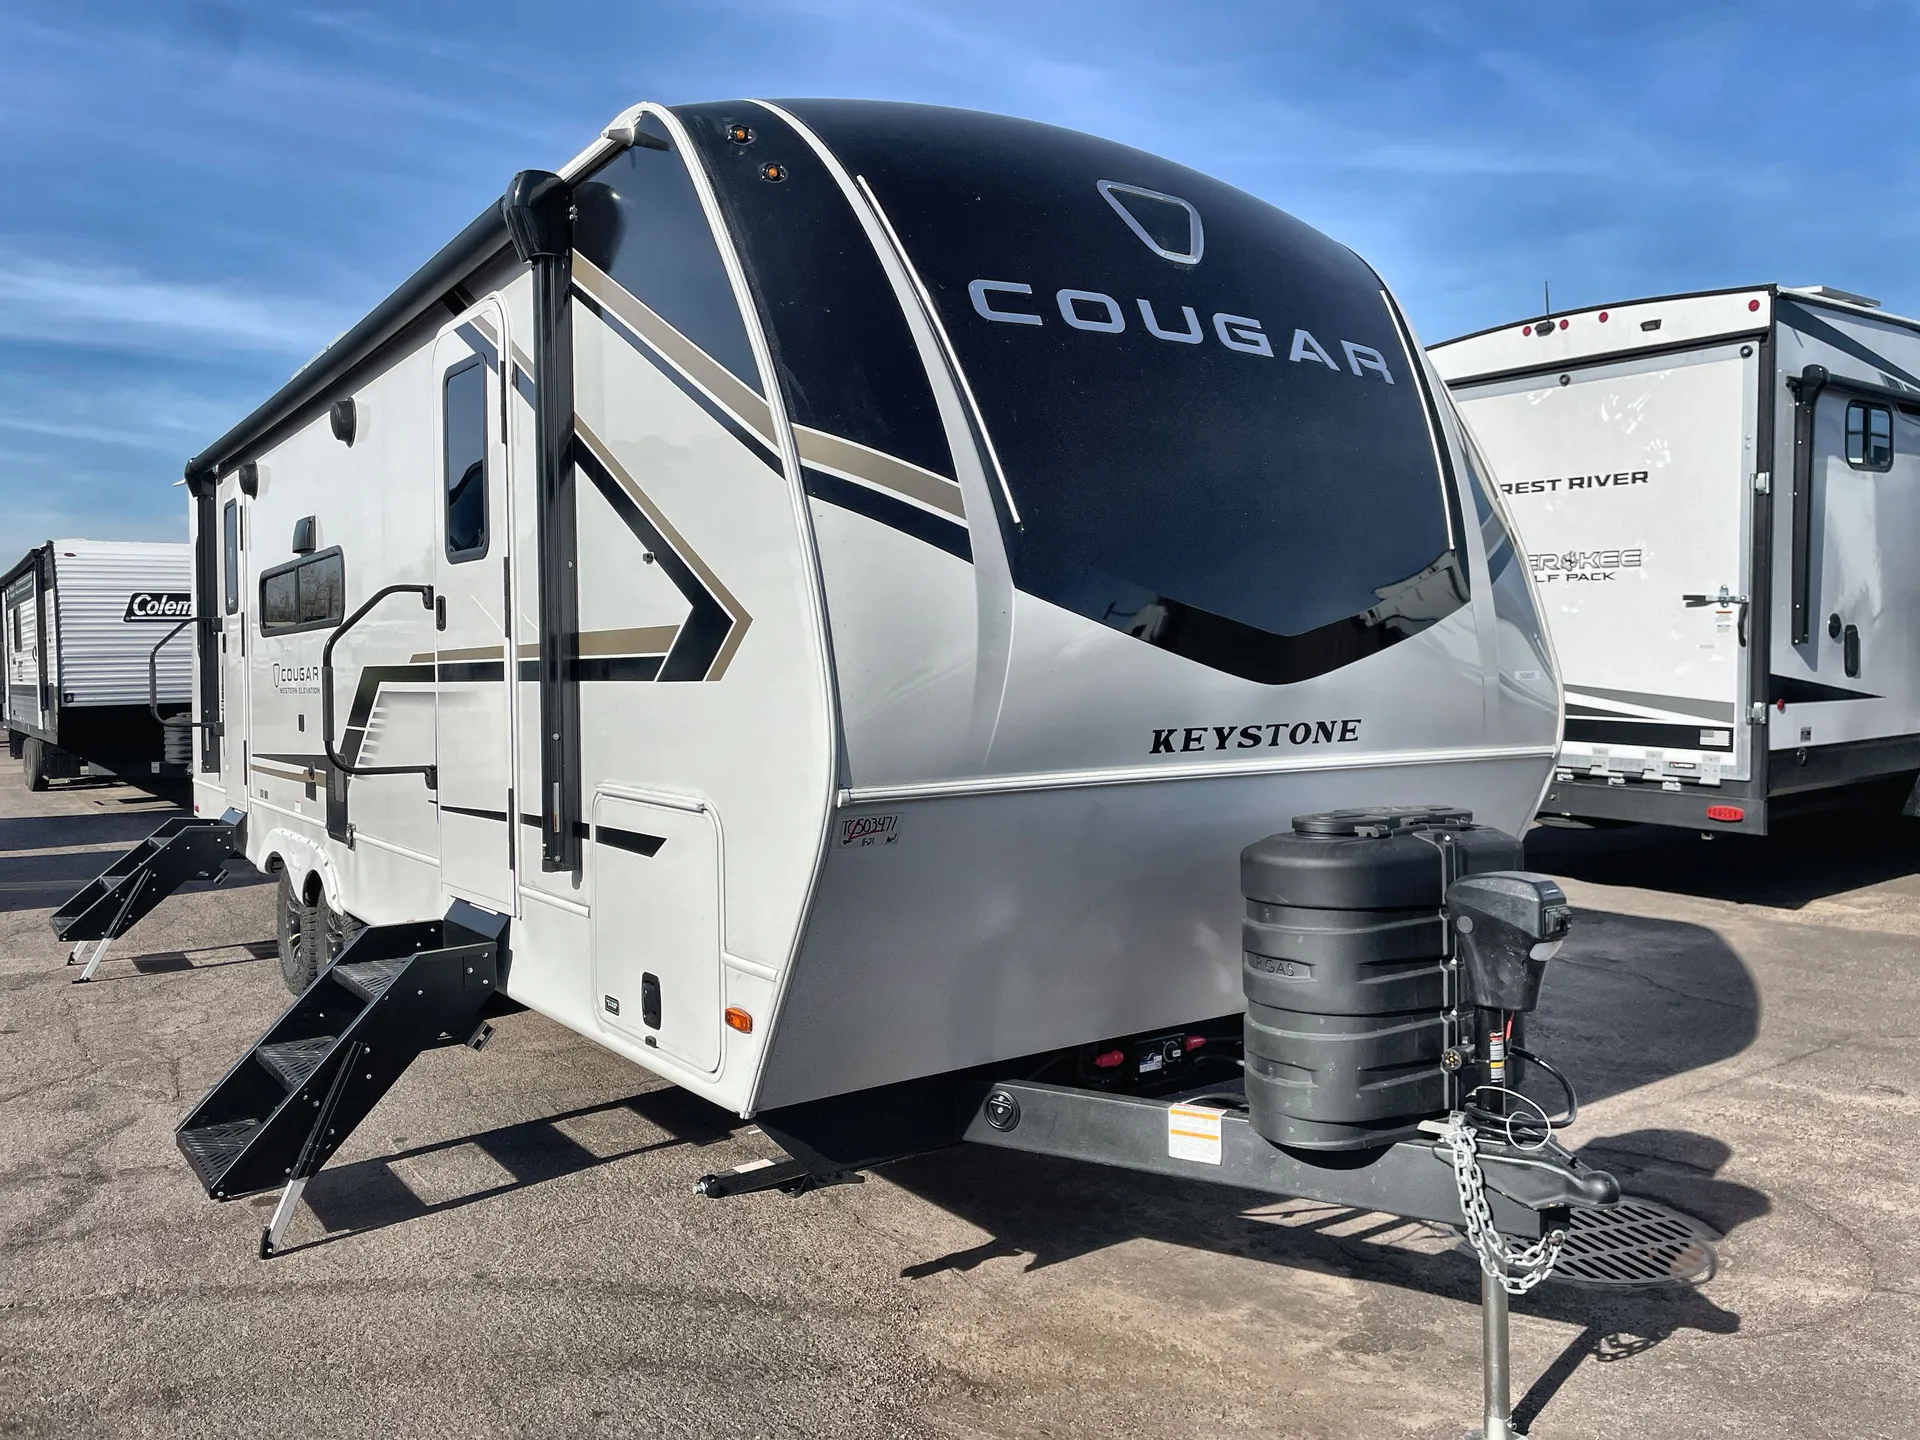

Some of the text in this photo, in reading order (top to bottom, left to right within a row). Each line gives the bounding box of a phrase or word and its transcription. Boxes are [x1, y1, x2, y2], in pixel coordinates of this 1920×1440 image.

[968, 279, 1395, 385] COUGAR
[1568, 471, 1648, 489] RIVER
[1566, 572, 1616, 581] PACK
[281, 666, 319, 681] COUGAR
[1149, 719, 1361, 754] KEYSTONE
[1264, 959, 1295, 977] GAS
